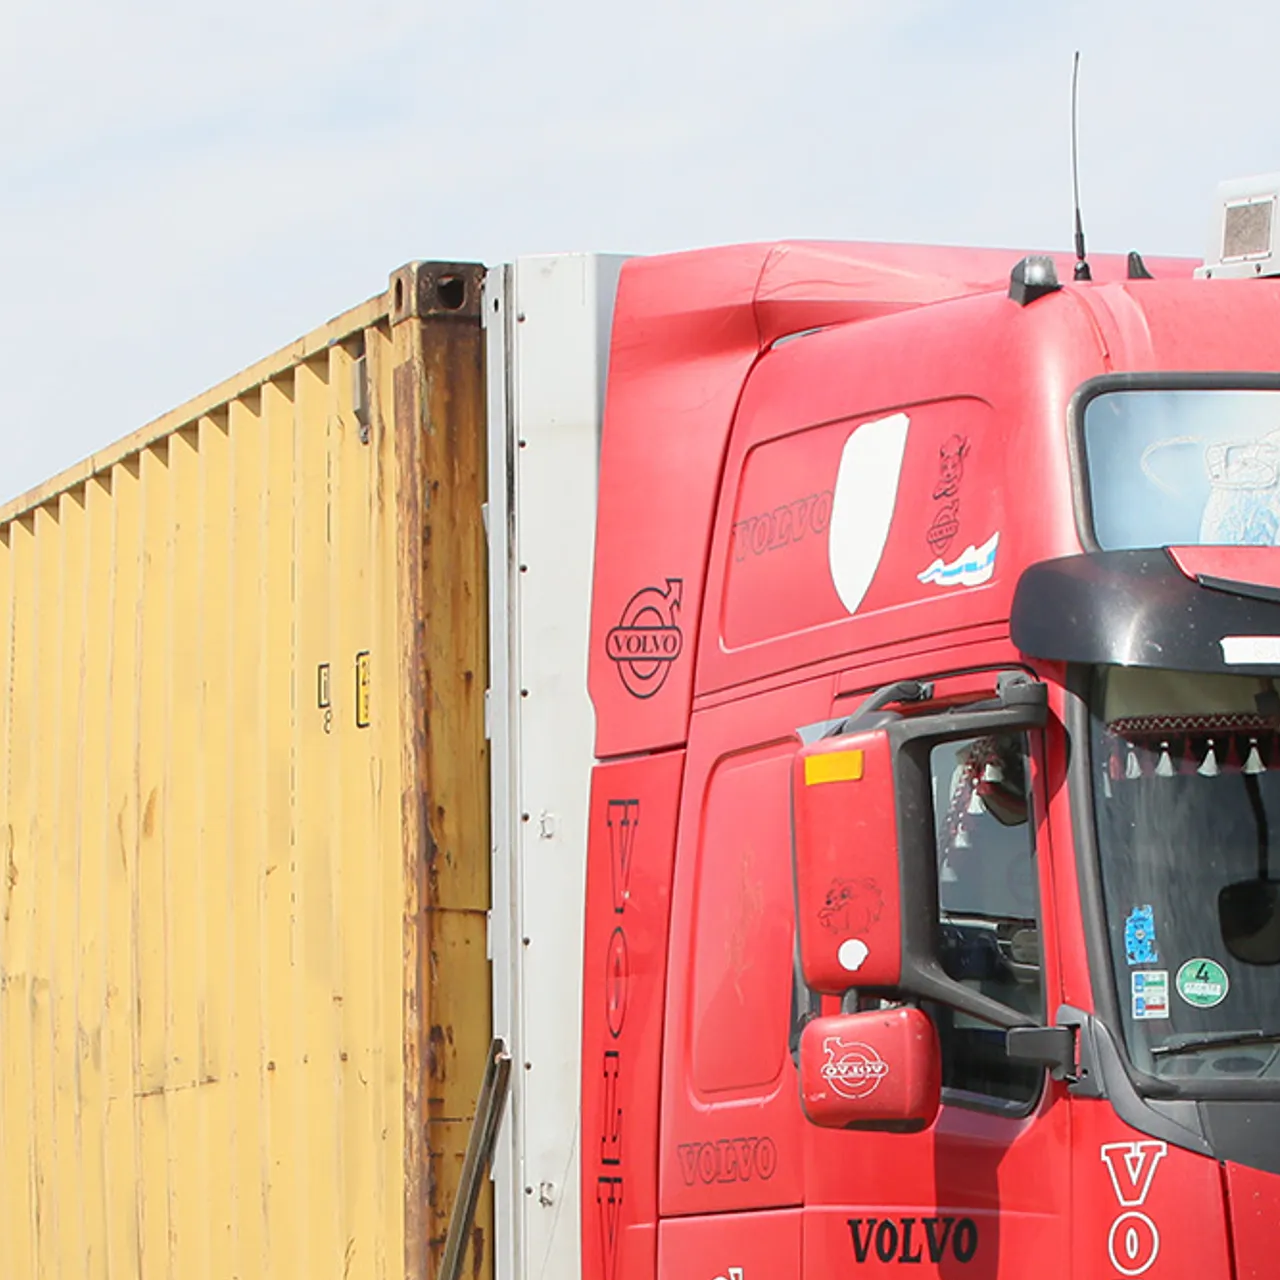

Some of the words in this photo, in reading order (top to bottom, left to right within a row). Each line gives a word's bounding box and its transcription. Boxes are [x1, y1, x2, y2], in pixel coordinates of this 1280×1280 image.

[613, 633, 678, 655] VOLVO
[677, 1136, 778, 1186] VOLVO
[847, 1216, 979, 1264] VOLVO
